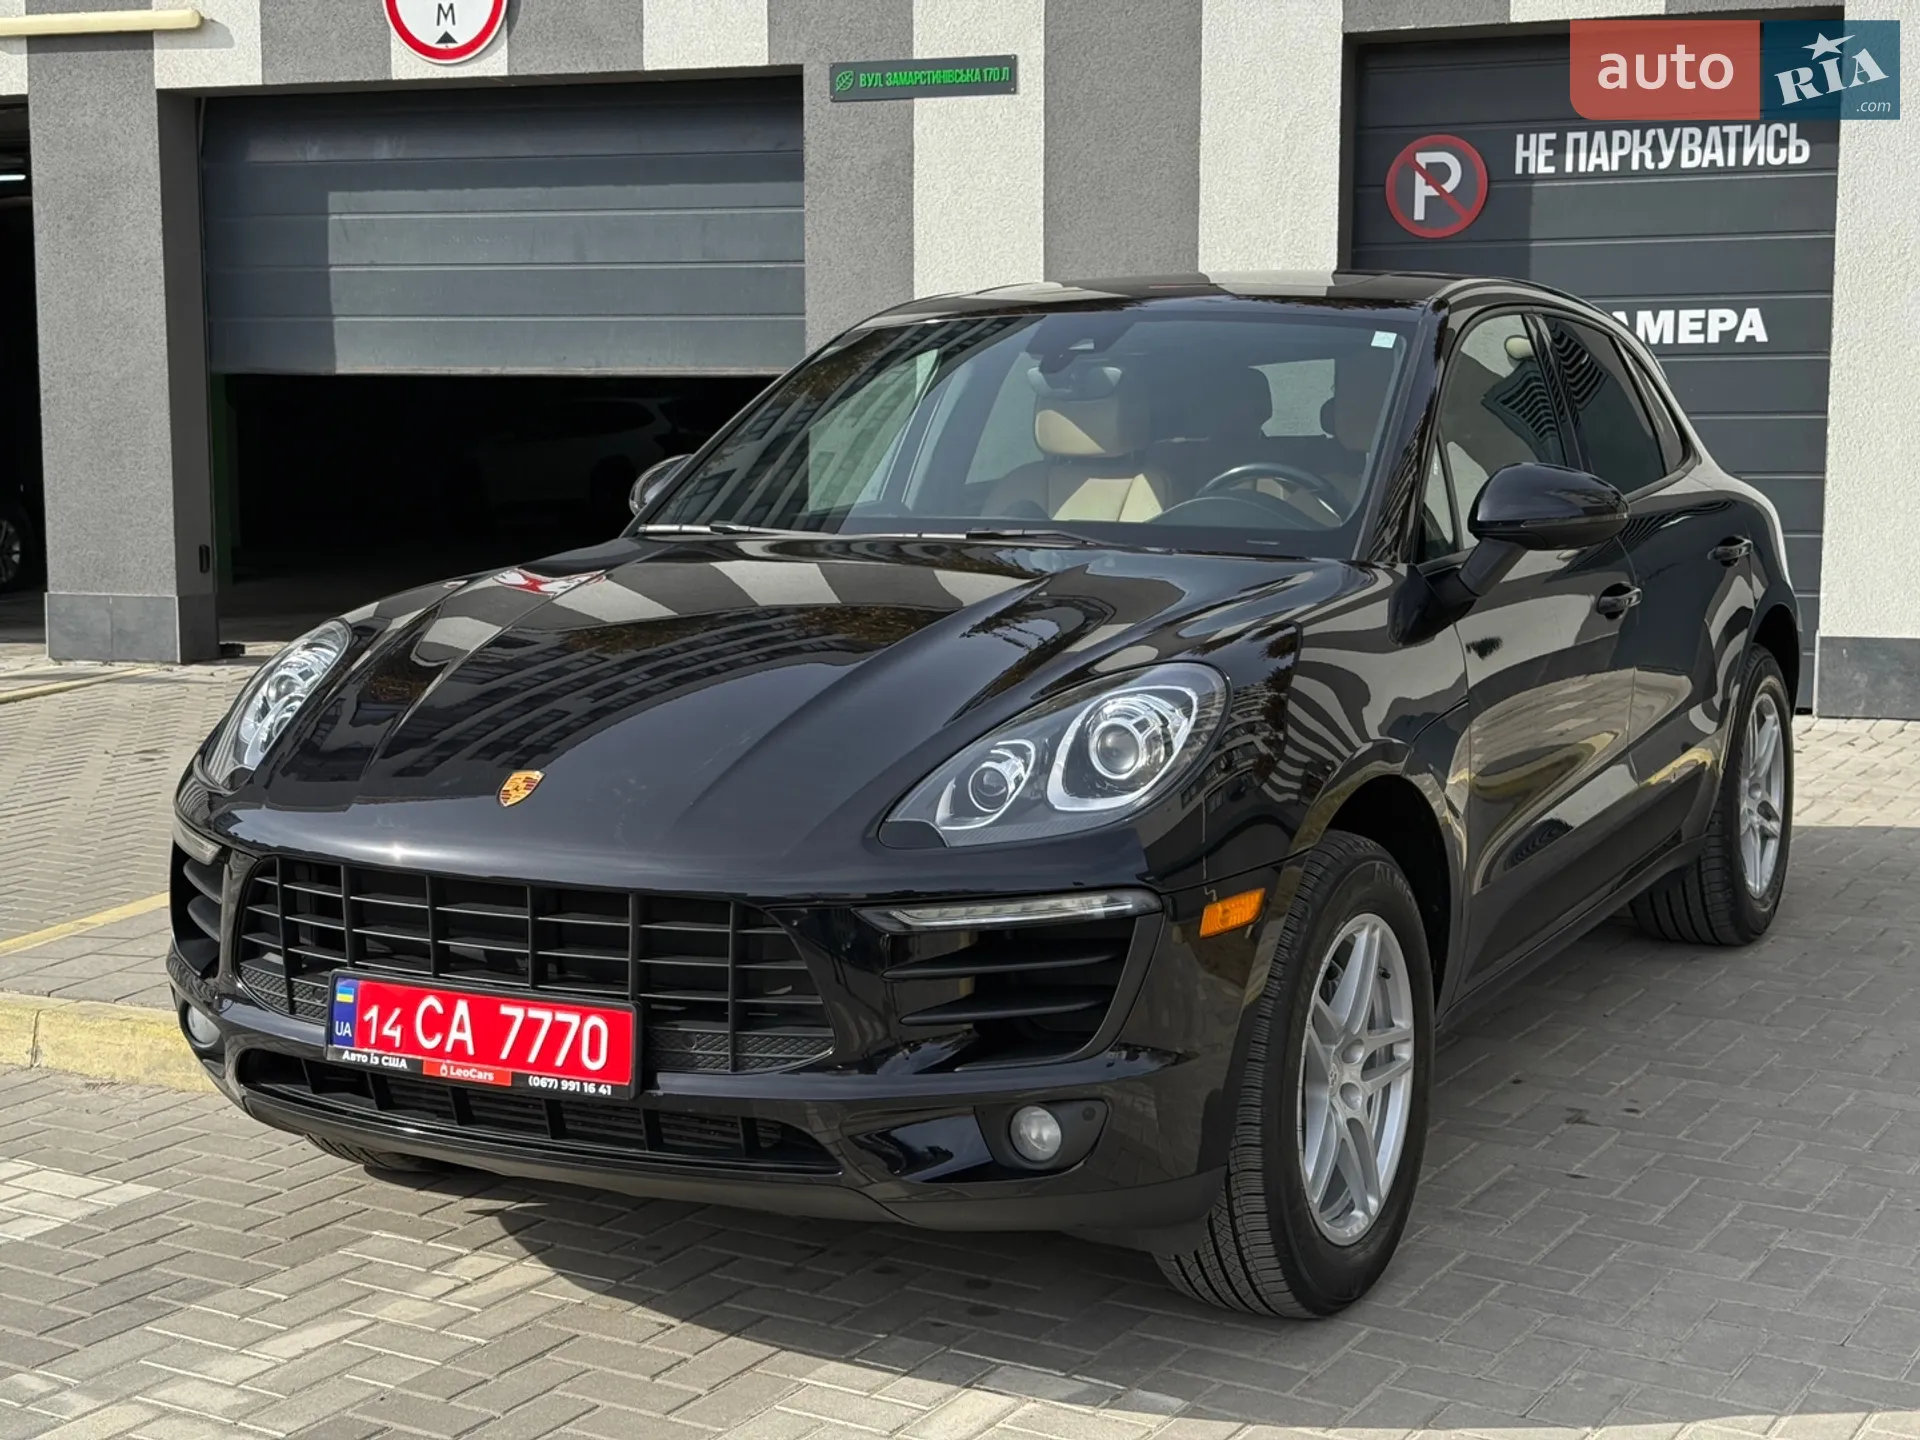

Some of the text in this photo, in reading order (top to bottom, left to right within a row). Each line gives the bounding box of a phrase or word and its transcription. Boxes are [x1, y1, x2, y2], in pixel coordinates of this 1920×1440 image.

[1514, 122, 1811, 175] НЕ ПАРКУВАТИСЬ
[1612, 308, 1769, 345] МЕРА
[335, 1021, 352, 1037] UA
[363, 1004, 403, 1048] 14
[500, 1003, 609, 1071] 7770
[342, 1050, 368, 1063] Авто
[381, 1056, 408, 1069] США
[450, 1065, 495, 1081] LeoCars
[528, 1075, 612, 1096] (067) 991 16 41
